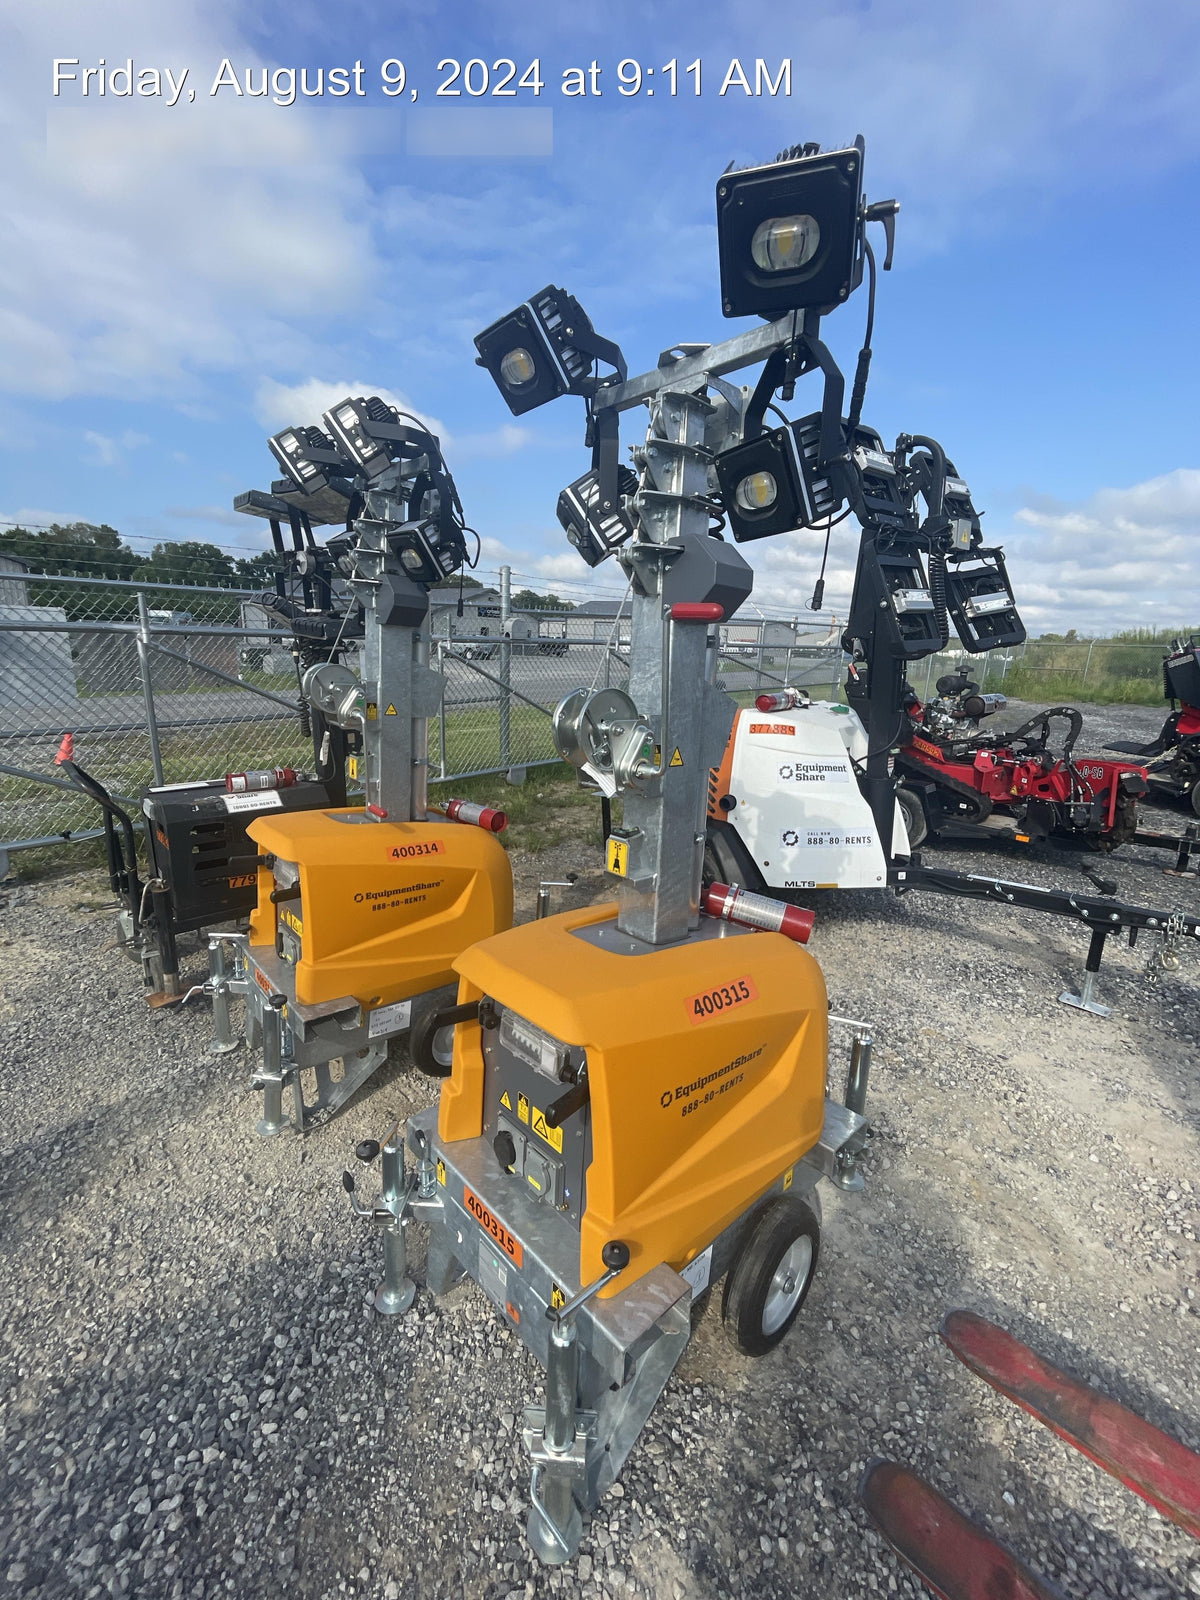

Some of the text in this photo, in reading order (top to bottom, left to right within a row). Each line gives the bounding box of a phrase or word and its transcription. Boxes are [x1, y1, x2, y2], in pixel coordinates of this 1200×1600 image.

[795, 763, 847, 774] Equipment
[795, 773, 826, 782] Share
[807, 836, 872, 845] 888-80-RENTS
[391, 842, 439, 859] 400314
[365, 880, 442, 900] EquipmentShare
[784, 880, 816, 888] MLTS
[371, 894, 427, 912] 888-80-RENTS
[693, 980, 751, 1017] 400315
[674, 1046, 763, 1101] EquipmentShare
[681, 1072, 745, 1117] 888-80-RENTS
[467, 1195, 515, 1256] 400315
